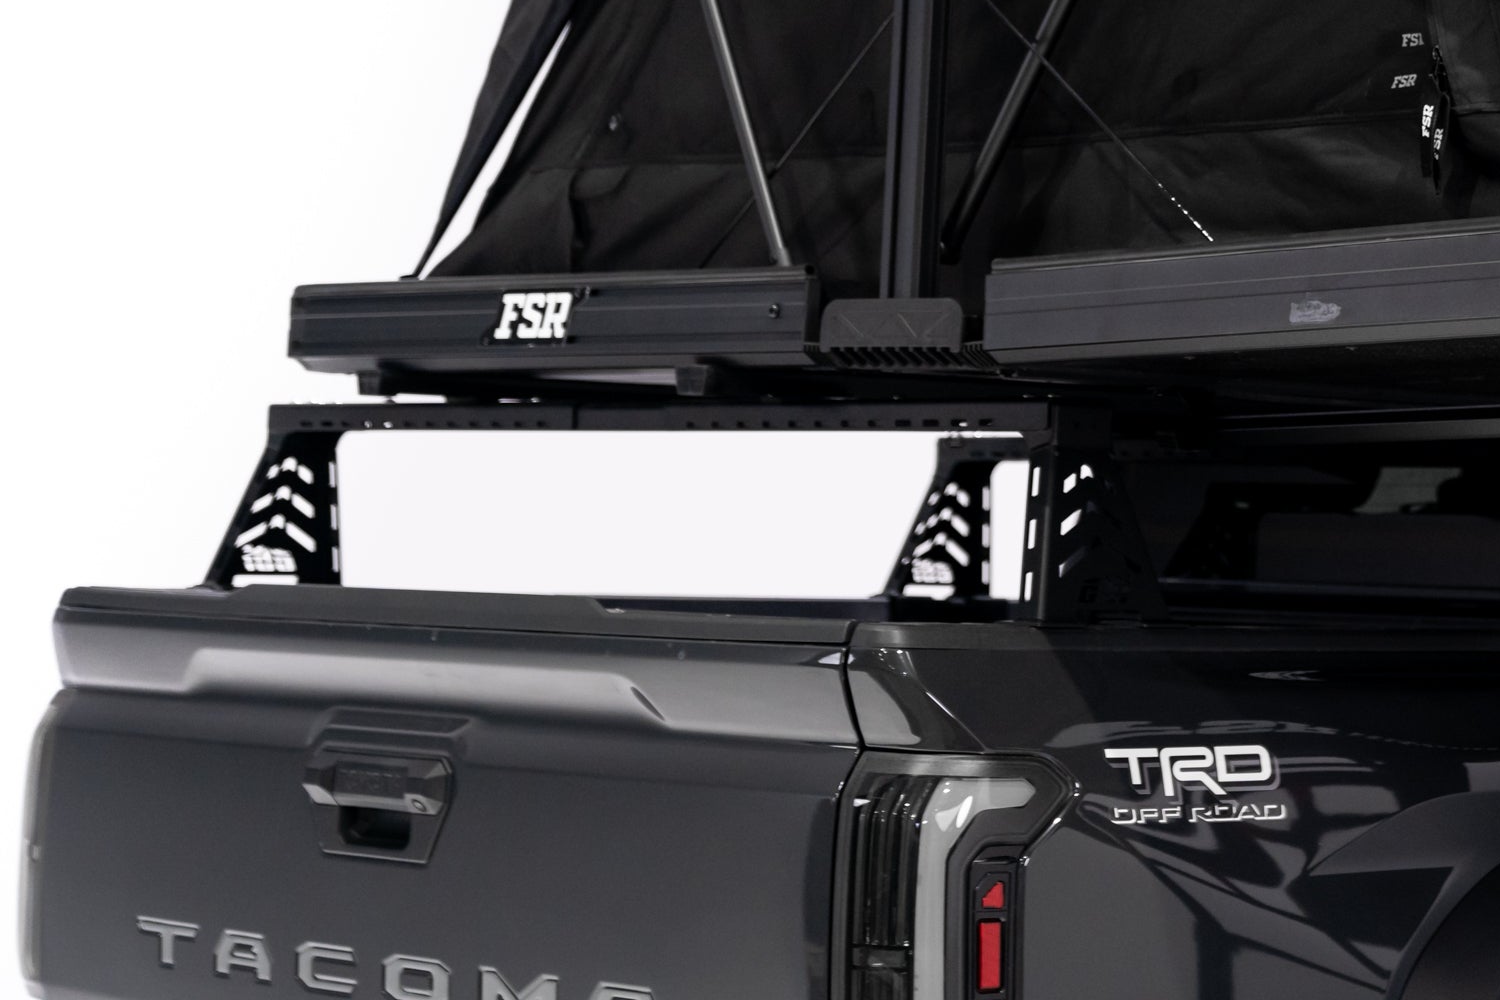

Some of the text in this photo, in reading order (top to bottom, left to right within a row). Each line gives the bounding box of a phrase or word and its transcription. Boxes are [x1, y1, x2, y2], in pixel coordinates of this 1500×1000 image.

[1391, 73, 1418, 89] FSR
[1421, 104, 1435, 139] FSR
[493, 292, 573, 340] FSR
[1104, 744, 1272, 797] TRD
[1111, 804, 1287, 825] OFF ROAD
